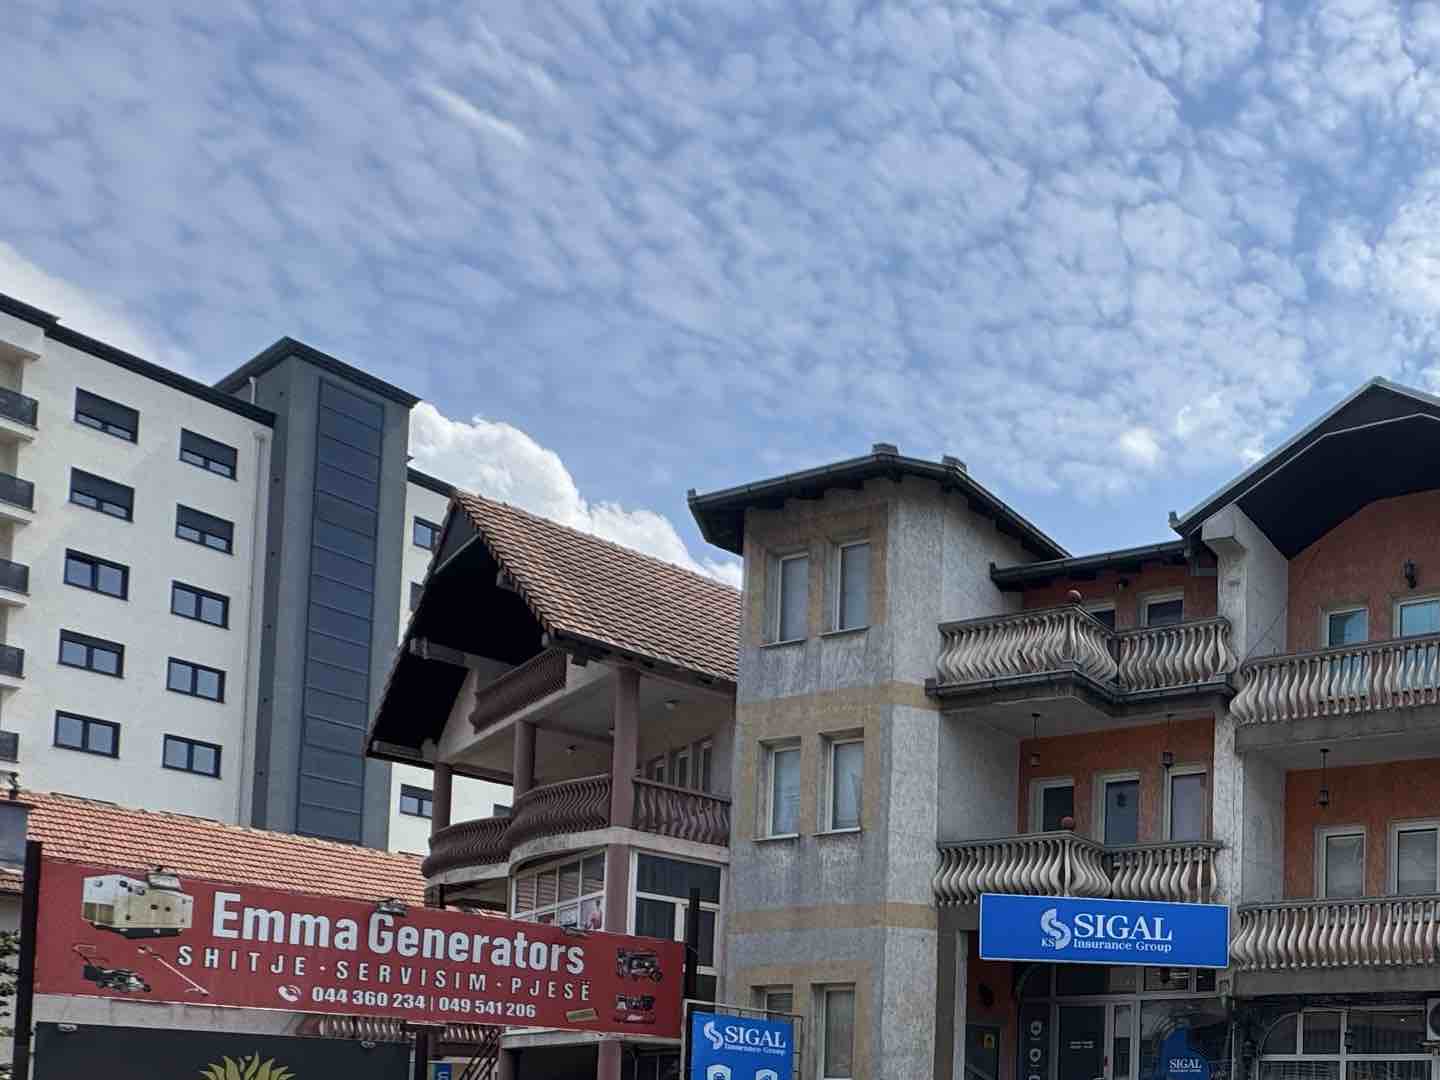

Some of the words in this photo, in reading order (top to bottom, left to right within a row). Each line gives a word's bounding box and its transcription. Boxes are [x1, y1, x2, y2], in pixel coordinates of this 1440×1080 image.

[212, 891, 358, 951] Emma
[367, 911, 585, 975] Generators
[1073, 913, 1173, 941] SIGAL
[1073, 938, 1132, 951] Insurance
[1135, 941, 1172, 953] Group
[177, 945, 307, 976] SHITJE
[336, 960, 487, 993] SERVISIM
[511, 977, 591, 1001] PJESË
[312, 986, 348, 1003] 044
[352, 989, 388, 1007] 360
[392, 993, 425, 1009] 234
[439, 996, 470, 1014] 049
[474, 1001, 502, 1016] 541
[505, 1003, 536, 1018] 206
[724, 1025, 787, 1049] SIGAL
[1169, 1058, 1203, 1069] SIGAL
